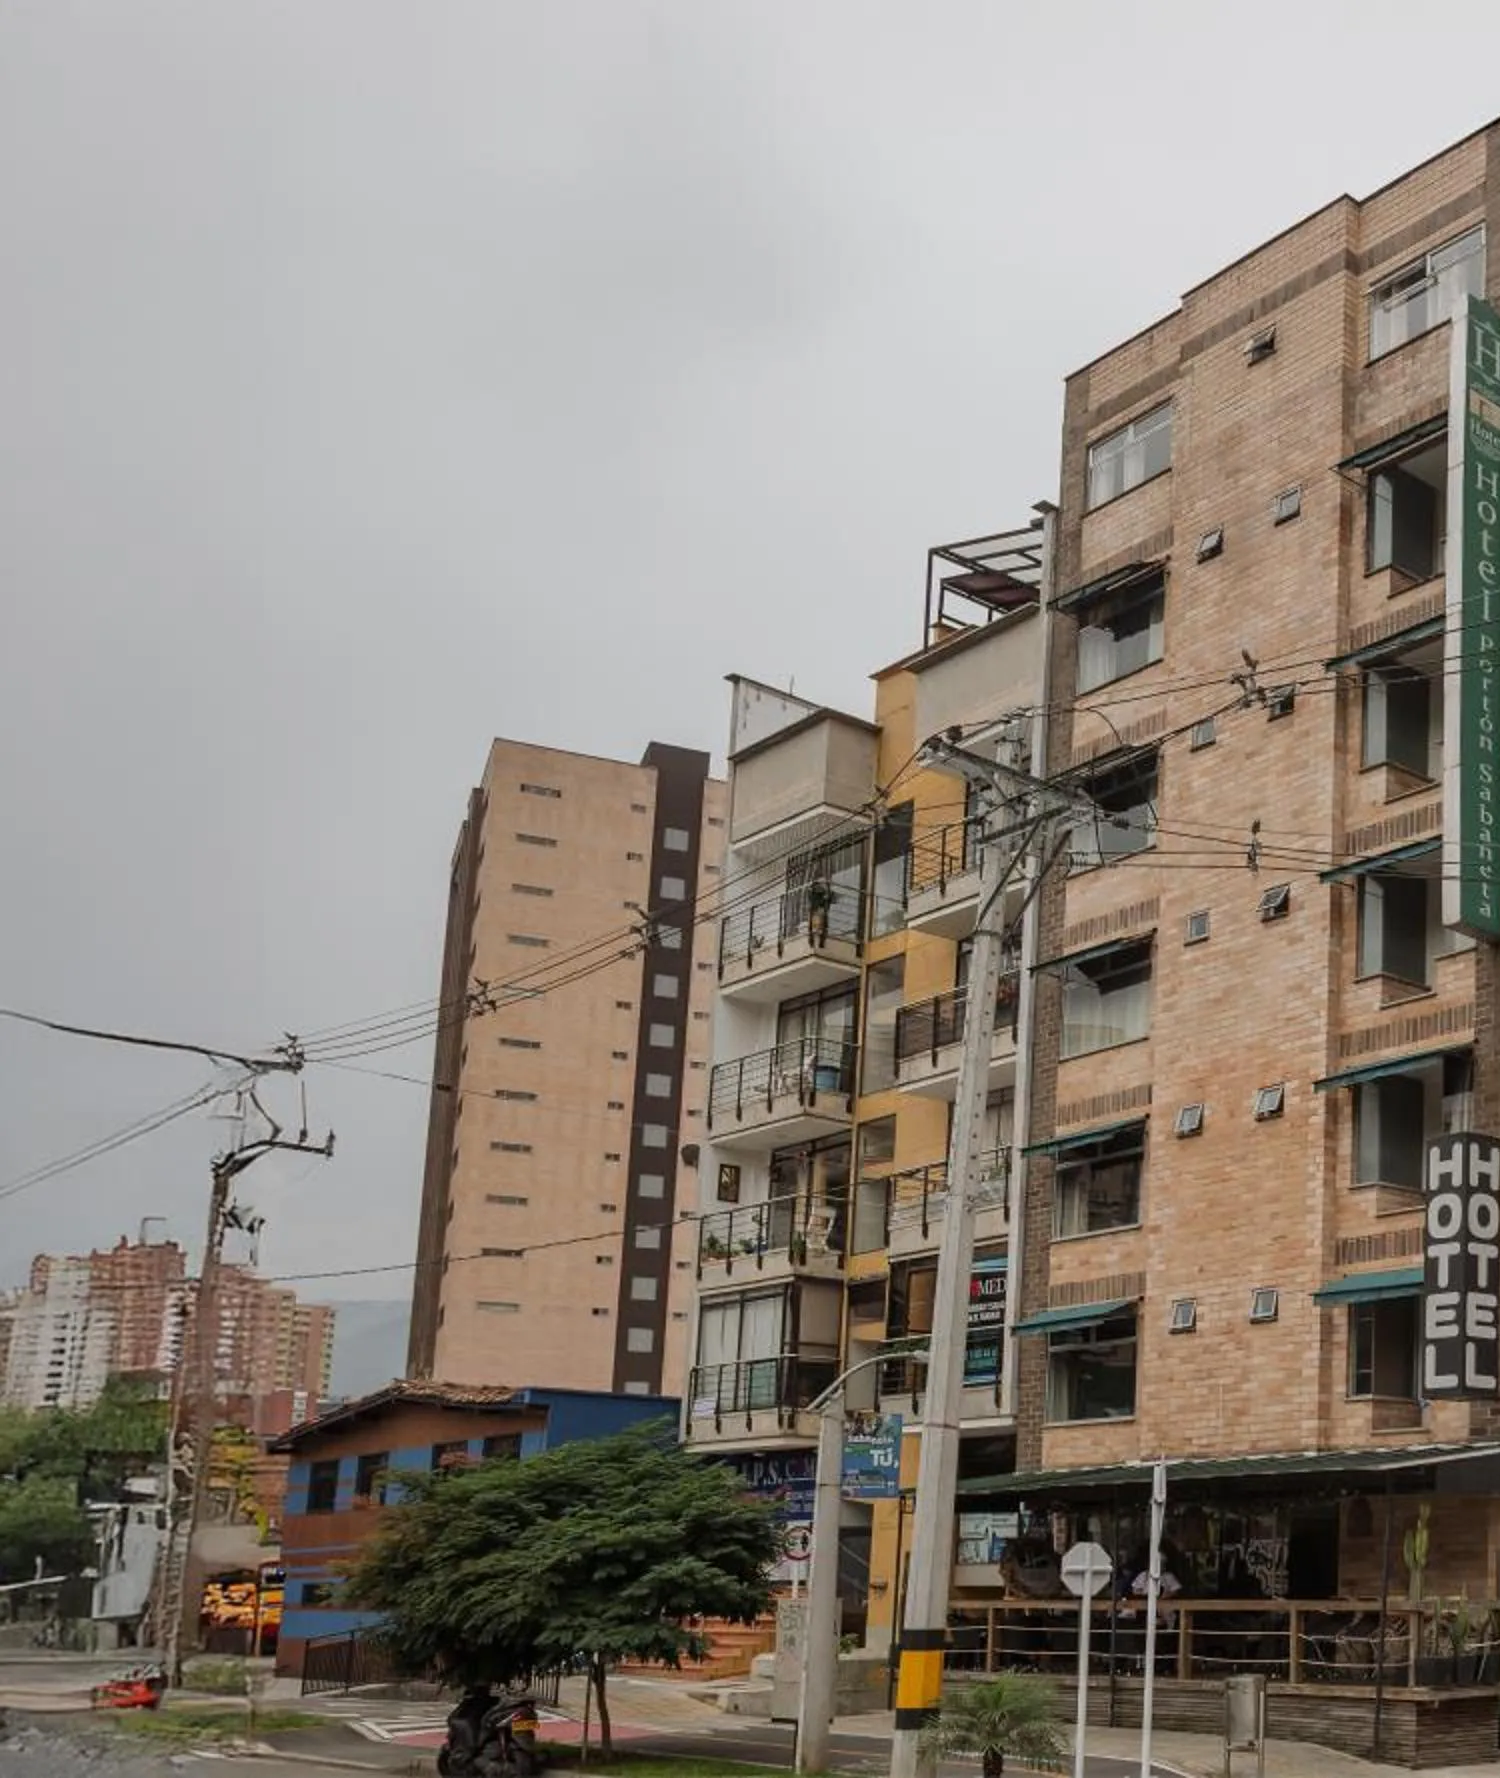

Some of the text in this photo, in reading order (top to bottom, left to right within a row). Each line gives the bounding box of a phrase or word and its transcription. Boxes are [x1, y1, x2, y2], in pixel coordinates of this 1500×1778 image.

[1475, 461, 1498, 621] Hotel
[1479, 763, 1493, 918] Sabaneta
[1425, 1141, 1463, 1389] HOTEL
[1465, 1141, 1500, 1389] HOTEL
